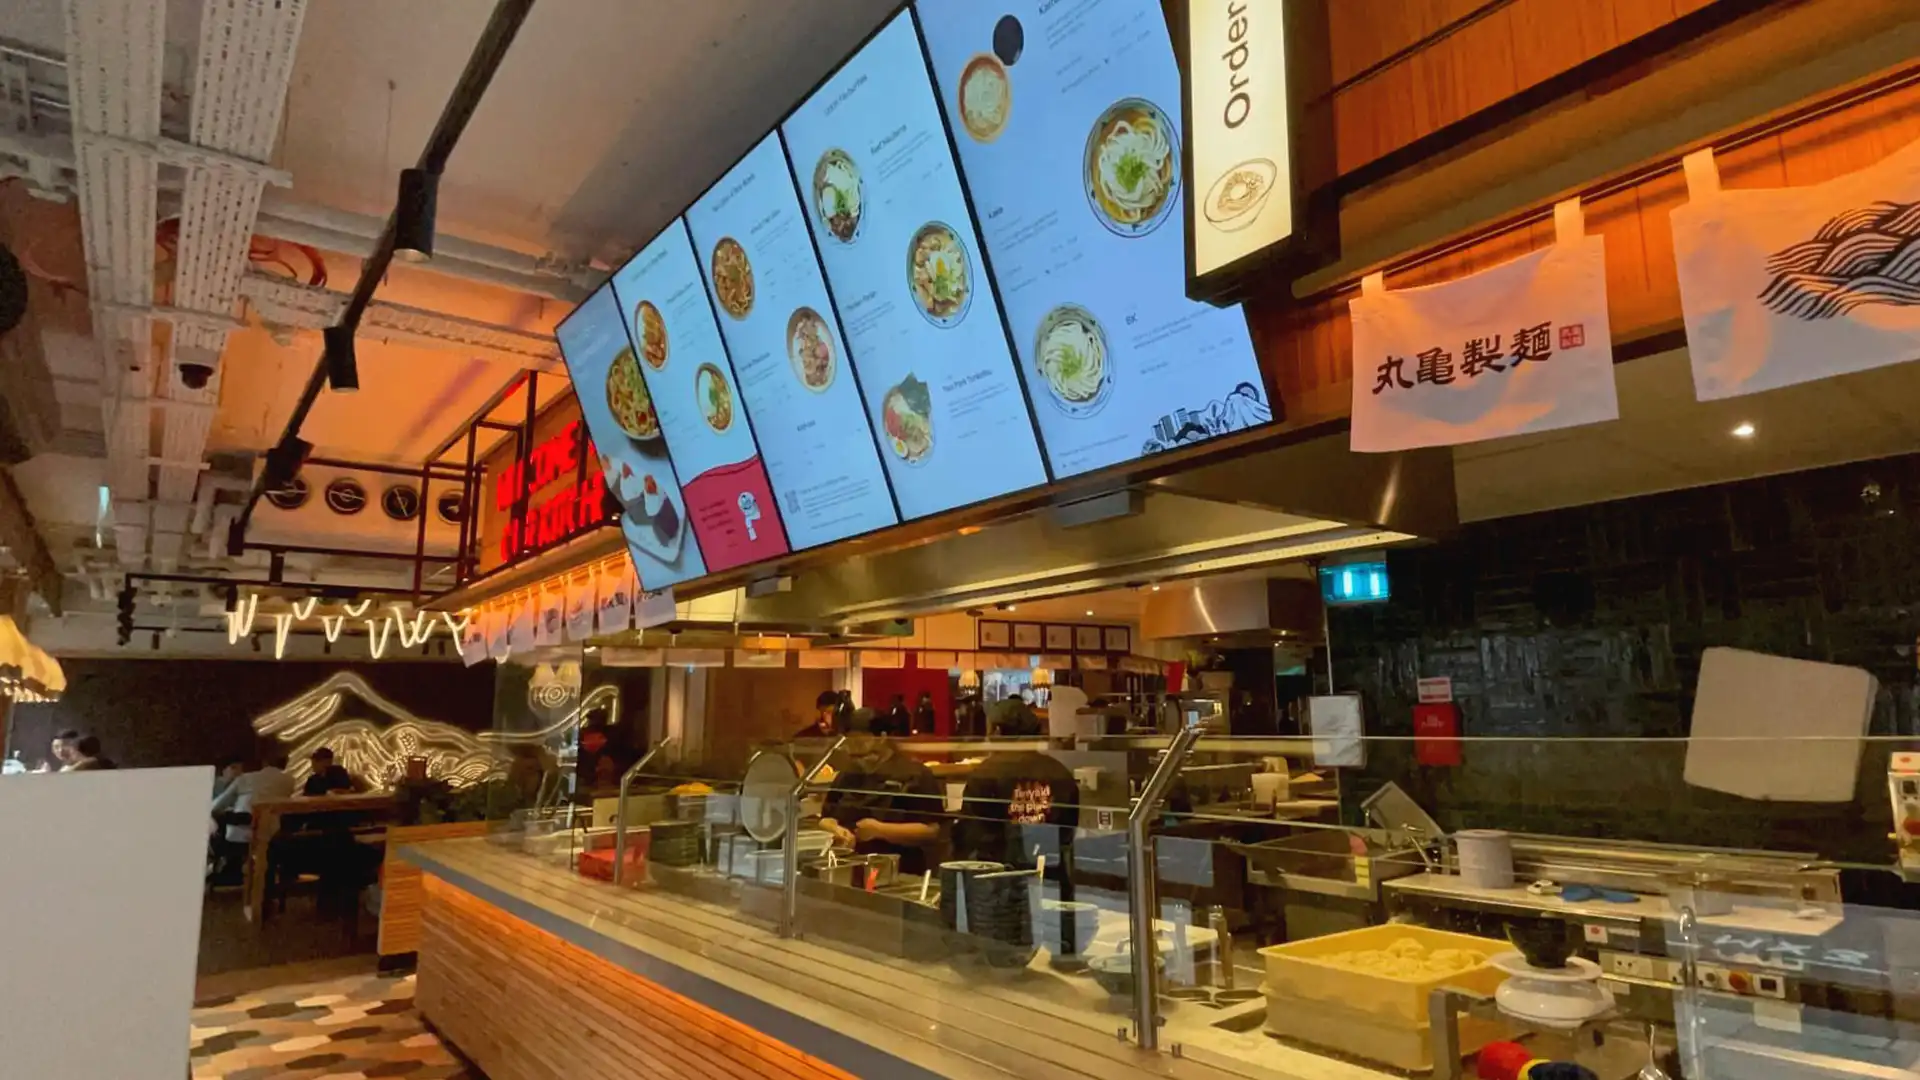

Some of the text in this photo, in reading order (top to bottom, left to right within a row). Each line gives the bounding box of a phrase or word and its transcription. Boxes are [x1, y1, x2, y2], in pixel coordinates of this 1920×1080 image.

[1222, 1, 1251, 129] Order
[1372, 321, 1552, 395] 丸亀製麺
